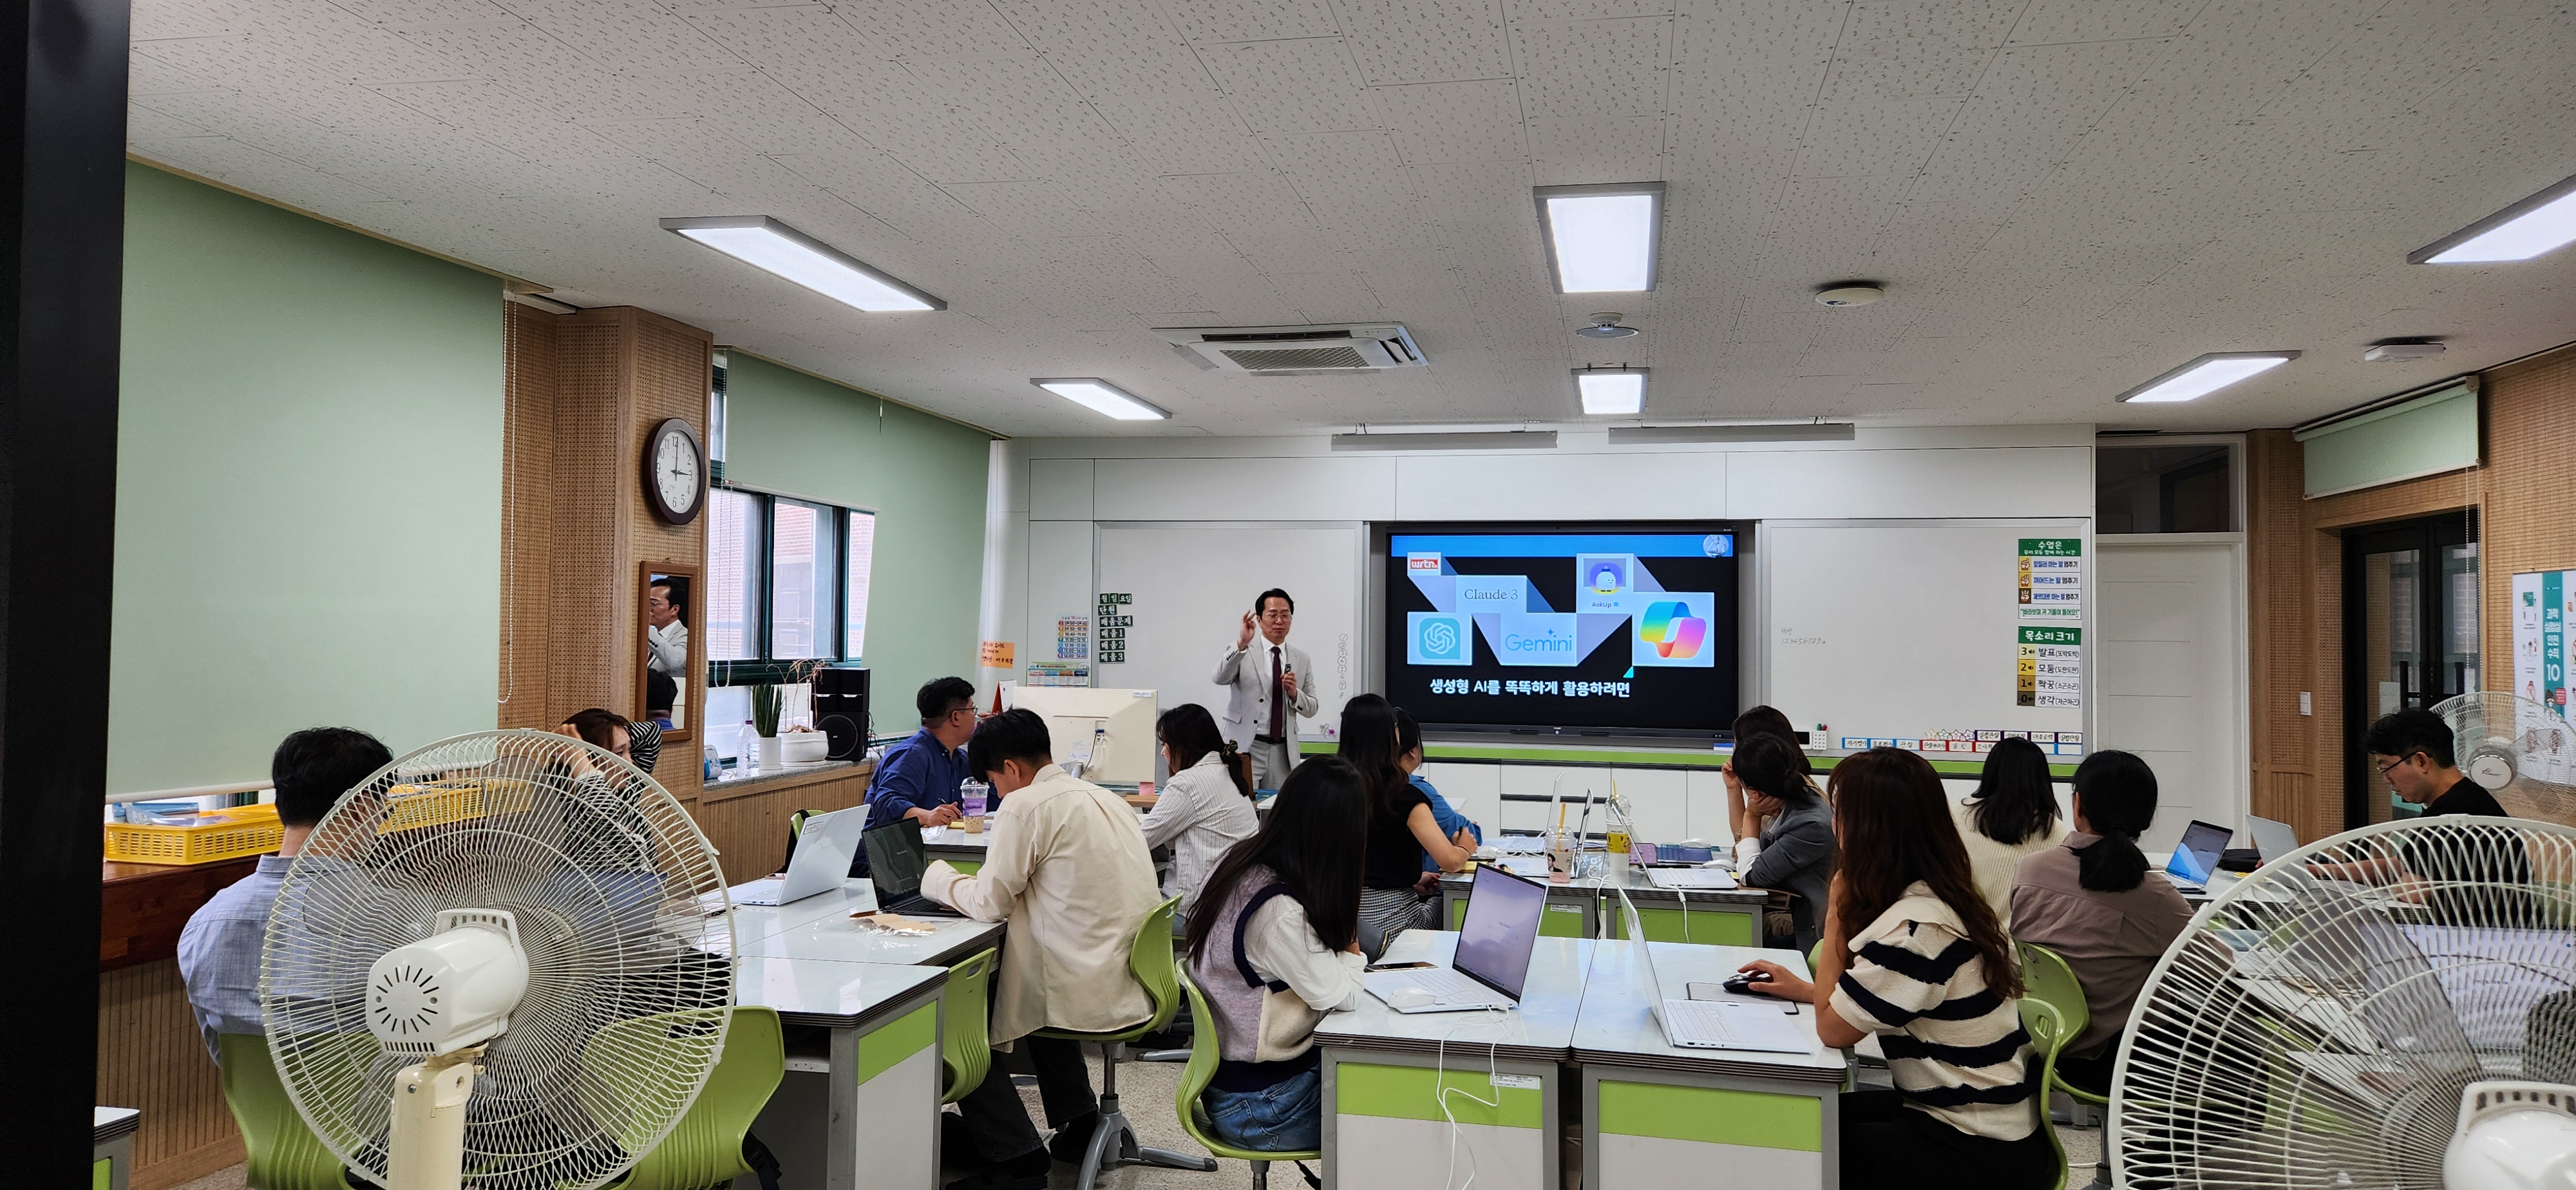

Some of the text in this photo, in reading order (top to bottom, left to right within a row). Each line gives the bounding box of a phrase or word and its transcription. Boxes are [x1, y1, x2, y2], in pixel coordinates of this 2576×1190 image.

[665, 439, 669, 449] 11
[672, 436, 679, 447] 12
[682, 443, 685, 453] 1
[687, 455, 691, 465] 2
[656, 462, 661, 473] 9
[688, 470, 693, 481] 3
[659, 478, 663, 489] 8
[687, 485, 690, 495] 4
[665, 491, 668, 502] 7
[672, 496, 676, 507] 6
[681, 495, 685, 505] 5
[2038, 541, 2063, 549] 수업은
[1464, 589, 1518, 600] Claude 3
[1099, 605, 1115, 615] 단원
[2546, 608, 2559, 619] 과학
[1101, 616, 1132, 627] 배움문제
[2544, 621, 2562, 632] 실험실
[2025, 630, 2074, 641] 목소리 크기
[2547, 634, 2559, 645] 안전
[1504, 632, 1572, 652] Gemini
[2547, 648, 2559, 659] 수칙
[2547, 664, 2560, 681] 10
[1430, 679, 1631, 697] 생성형 AI를 똑똑하게 활용하려면
